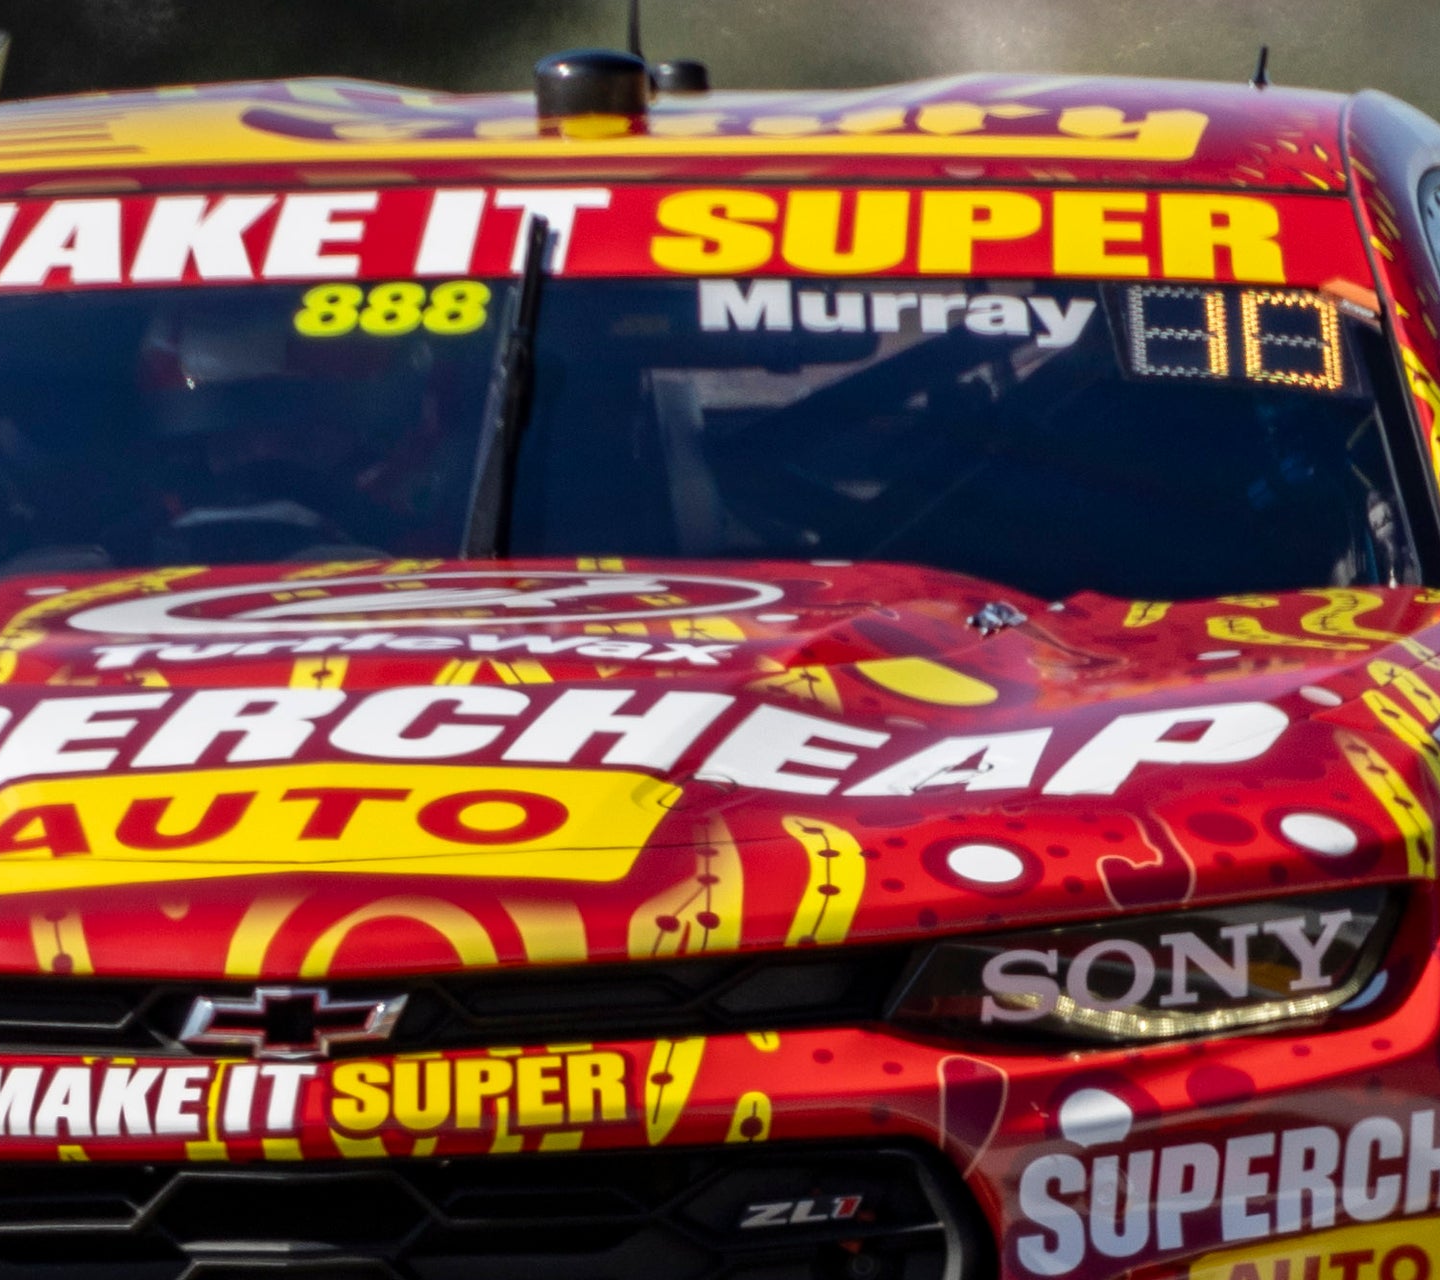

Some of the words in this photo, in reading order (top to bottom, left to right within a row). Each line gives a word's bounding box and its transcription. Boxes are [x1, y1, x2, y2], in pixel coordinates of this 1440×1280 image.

[414, 188, 611, 275] IT
[650, 189, 1285, 283] SUPER
[294, 280, 490, 336] 888
[699, 279, 1096, 348] Murray
[981, 910, 1353, 1024] SONY
[223, 1064, 317, 1133] IT
[332, 1051, 627, 1130] SUPER
[739, 1195, 864, 1228] ZL1
